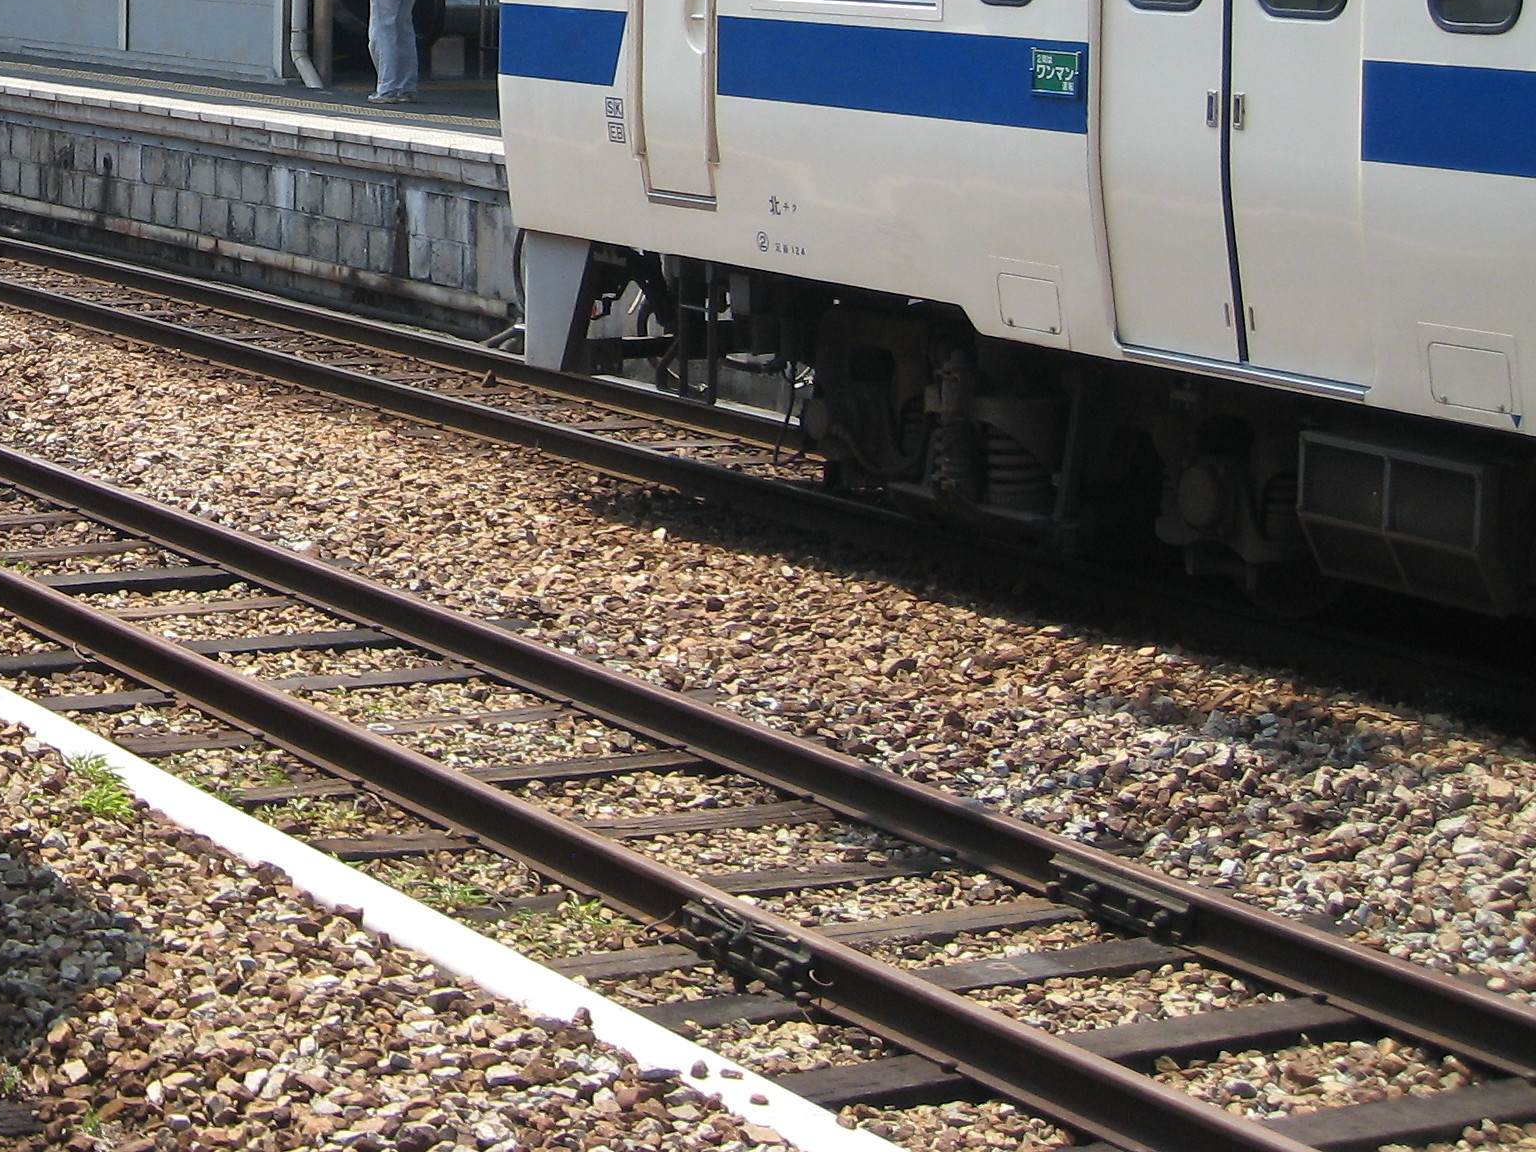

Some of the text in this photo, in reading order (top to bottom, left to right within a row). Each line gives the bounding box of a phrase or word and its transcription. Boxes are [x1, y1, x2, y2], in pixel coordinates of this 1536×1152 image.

[1036, 64, 1074, 81] ワンマン
[609, 125, 624, 139] EB
